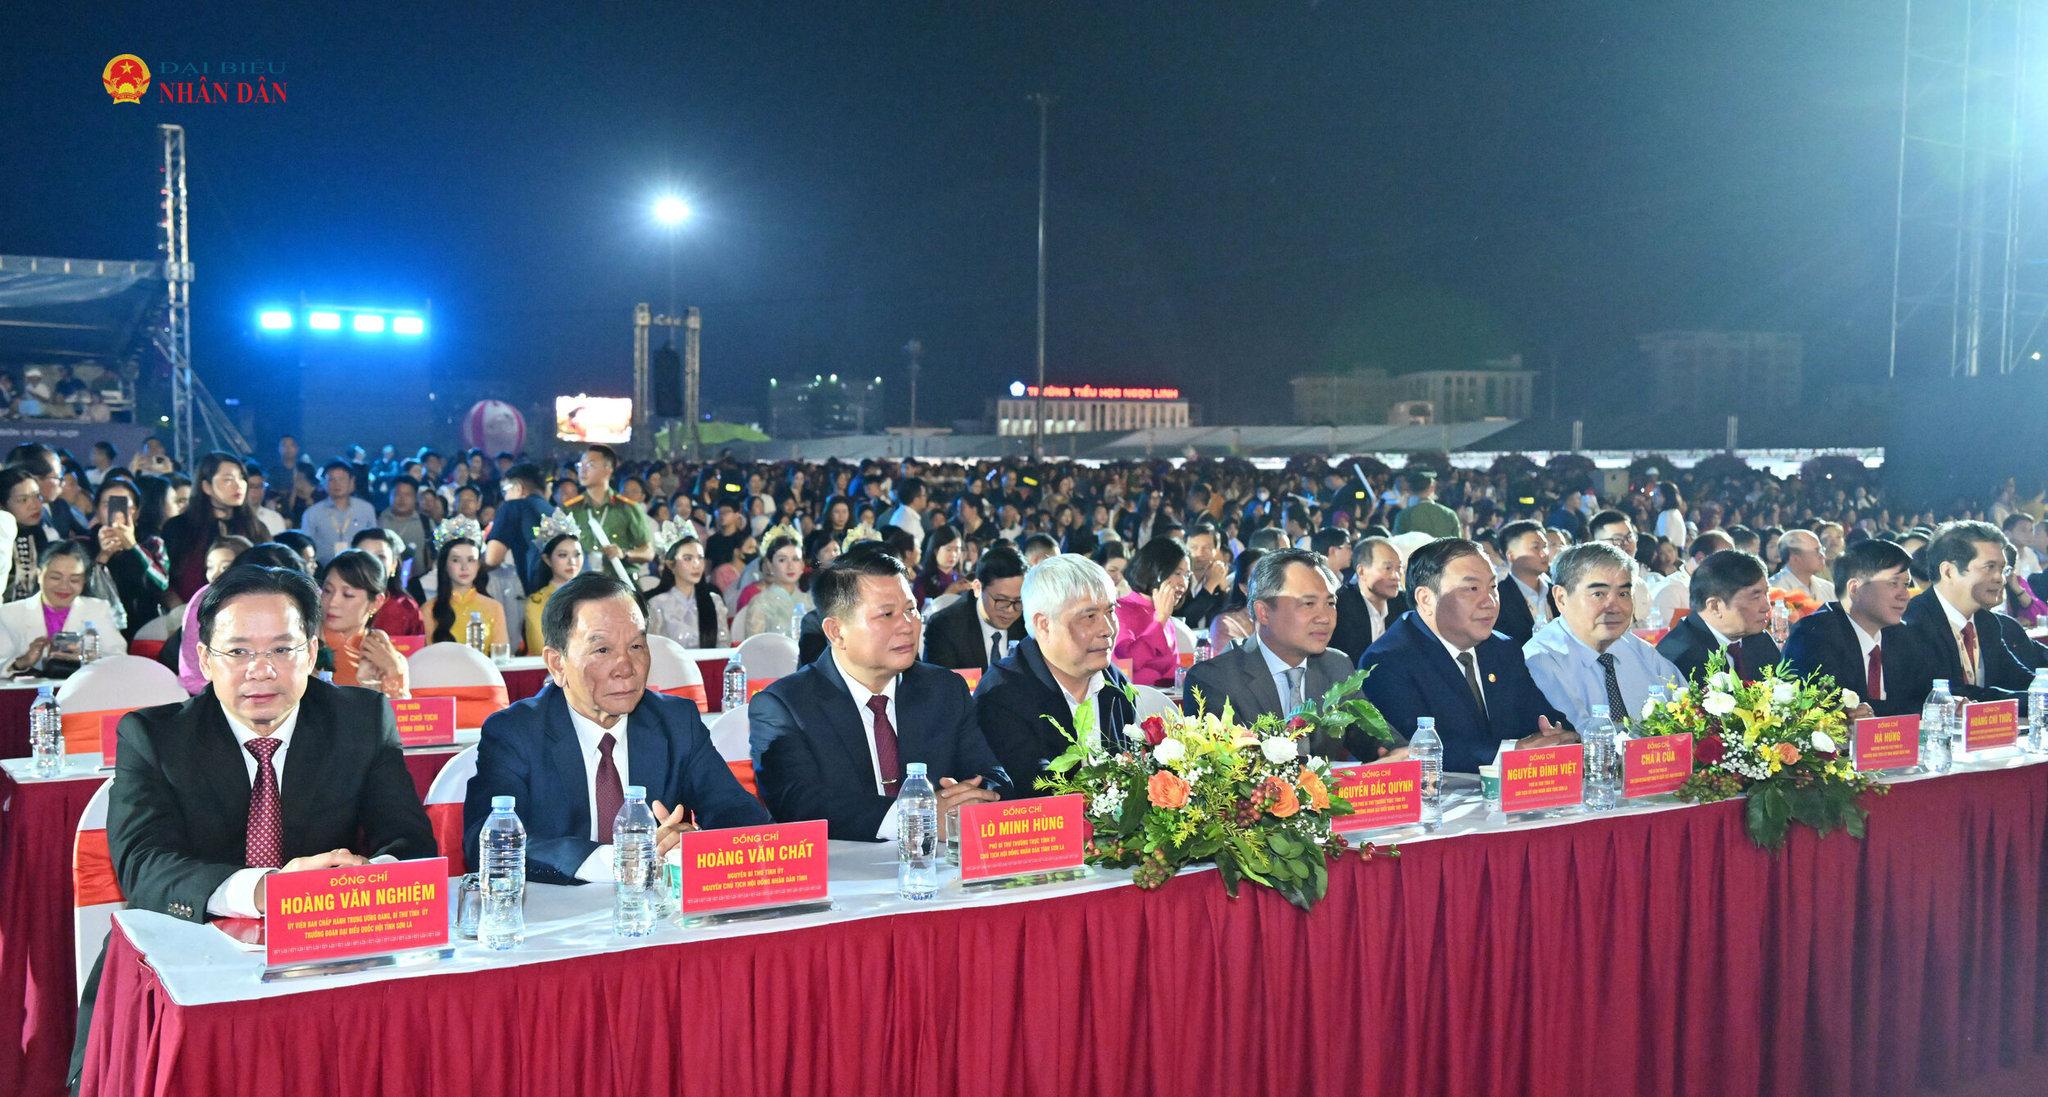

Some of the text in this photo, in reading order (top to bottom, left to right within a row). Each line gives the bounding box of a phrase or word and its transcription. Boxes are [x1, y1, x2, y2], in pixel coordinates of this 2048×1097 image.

[1153, 388, 1179, 398] LINH
[1361, 770, 1380, 779] ĐỒNG
[1507, 763, 1538, 781] NGUYỄN
[1560, 760, 1577, 776] VIỆT
[1338, 776, 1414, 799] NGUYỄN ĐẮC QUỲNH
[1003, 803, 1042, 816] ĐỒNG CHÍ
[981, 814, 1064, 838] LÒ MINH HÙNG
[732, 831, 779, 844] ĐỒNG CHÍ
[697, 838, 814, 868] HOÀNG VĂN CHẤT
[330, 871, 388, 887] ĐỒNG CHÍ
[281, 881, 435, 915] HOÀNG VĂN NGHIỆM
